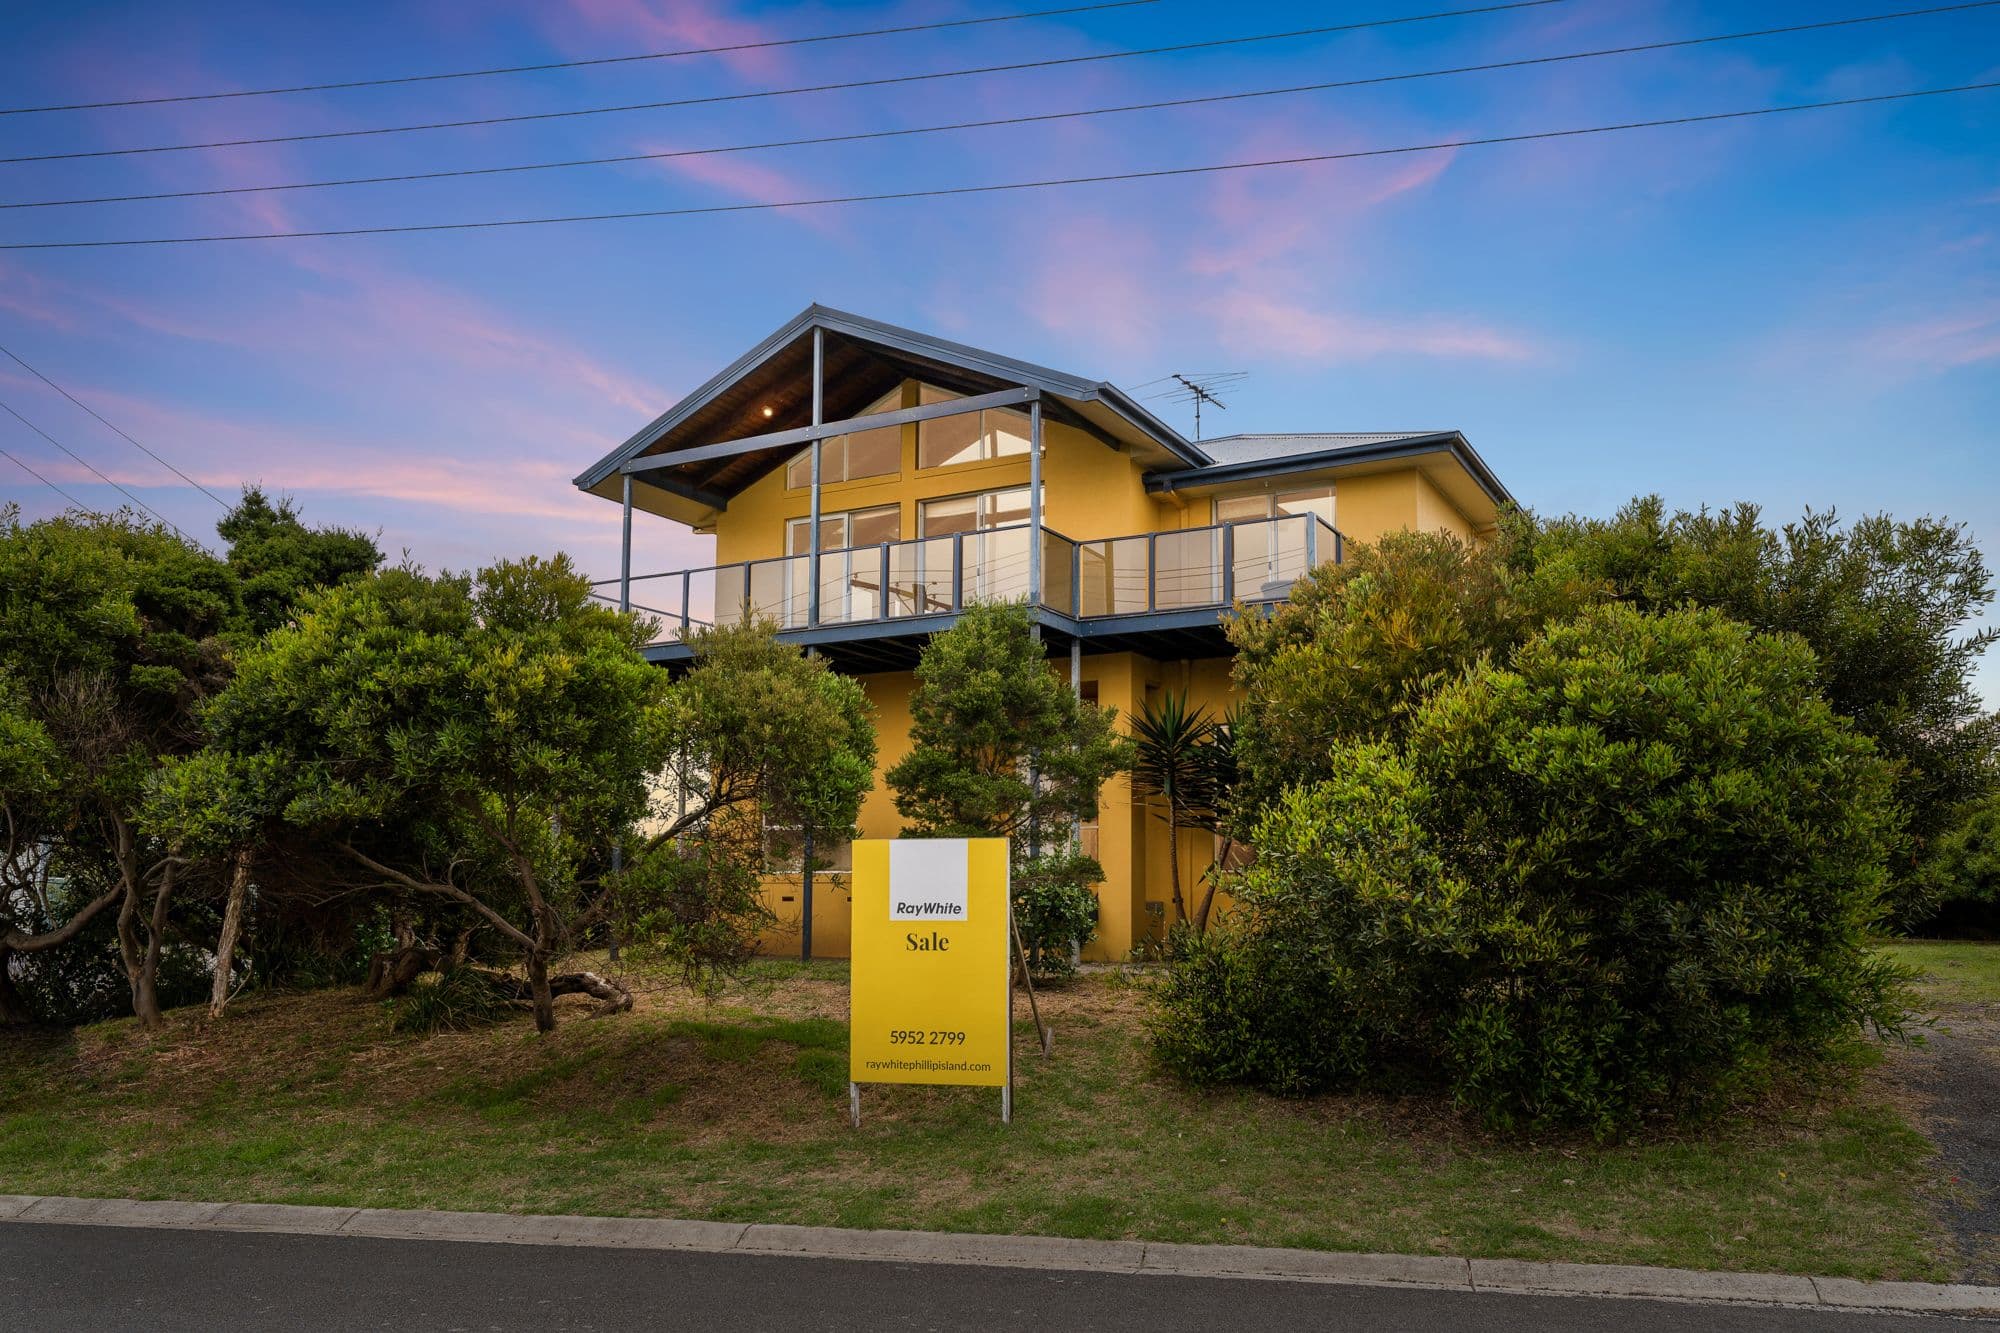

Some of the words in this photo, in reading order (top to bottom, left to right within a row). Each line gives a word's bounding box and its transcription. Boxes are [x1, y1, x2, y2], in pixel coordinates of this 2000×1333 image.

[906, 931, 950, 952] Sale
[890, 1030, 925, 1045] 5952
[929, 1030, 966, 1046] 2799
[866, 1059, 992, 1073] raywhitephillipisland.com
